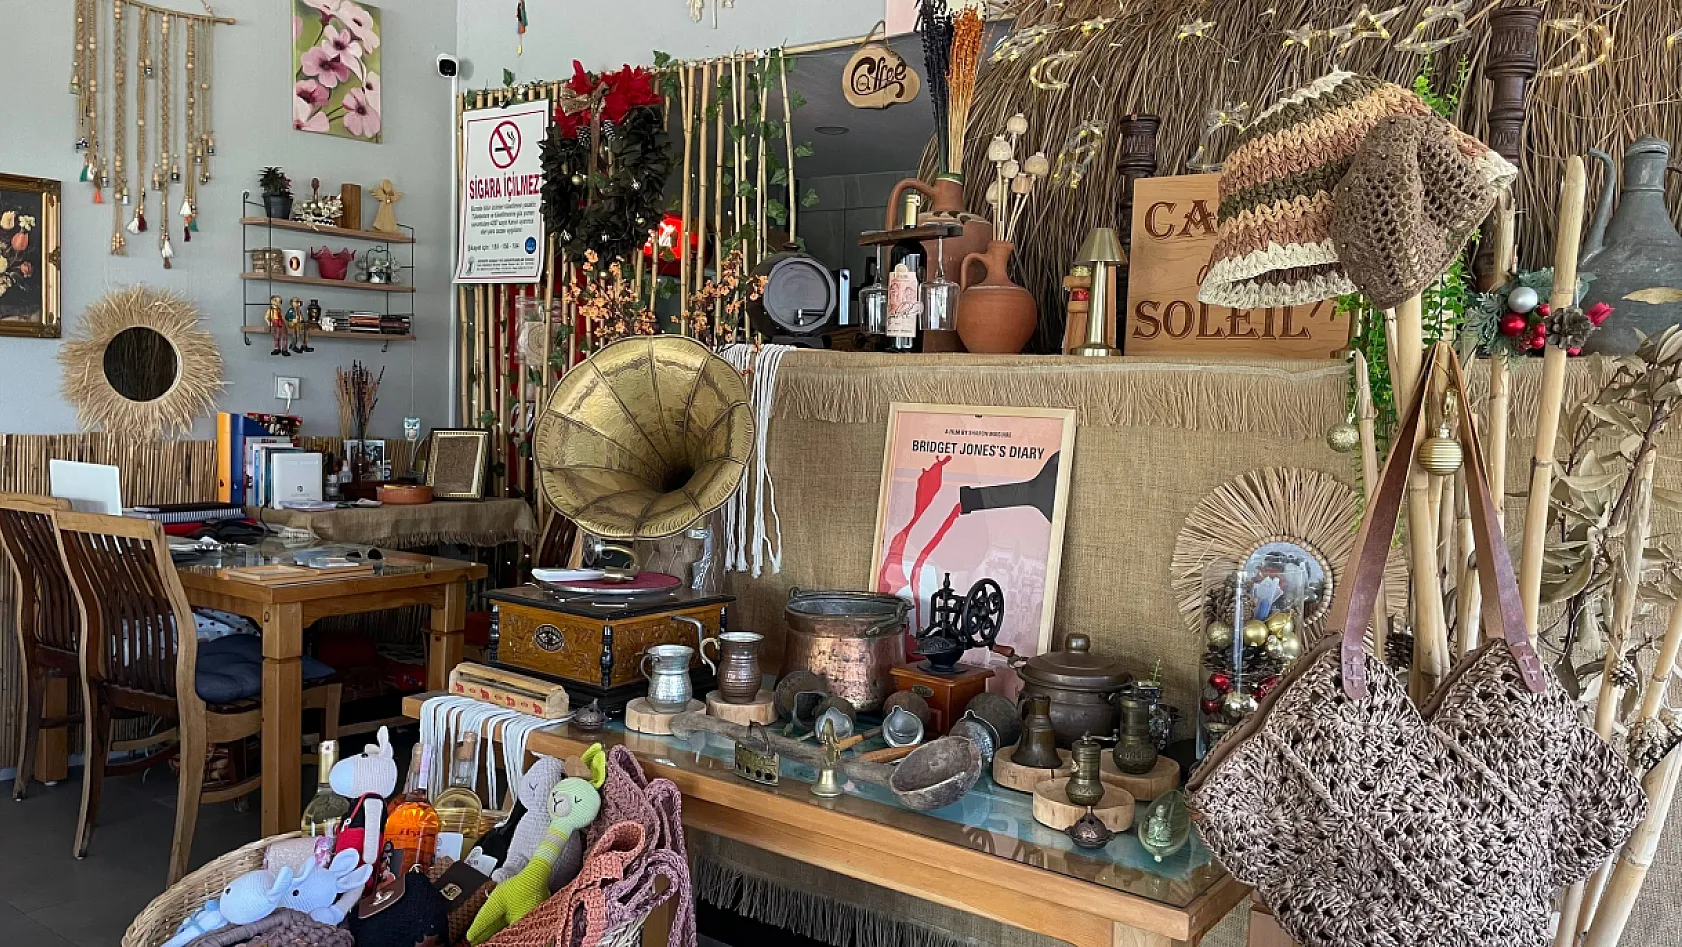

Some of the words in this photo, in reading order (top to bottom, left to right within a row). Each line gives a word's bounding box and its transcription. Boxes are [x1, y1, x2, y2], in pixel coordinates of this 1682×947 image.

[469, 175, 501, 200] SİGARA
[1144, 199, 1218, 240] CA
[1133, 300, 1312, 341] SOLEIL
[912, 440, 958, 454] BRIDGET
[959, 442, 1007, 457] JONES'S
[1009, 446, 1045, 460] DIARY
